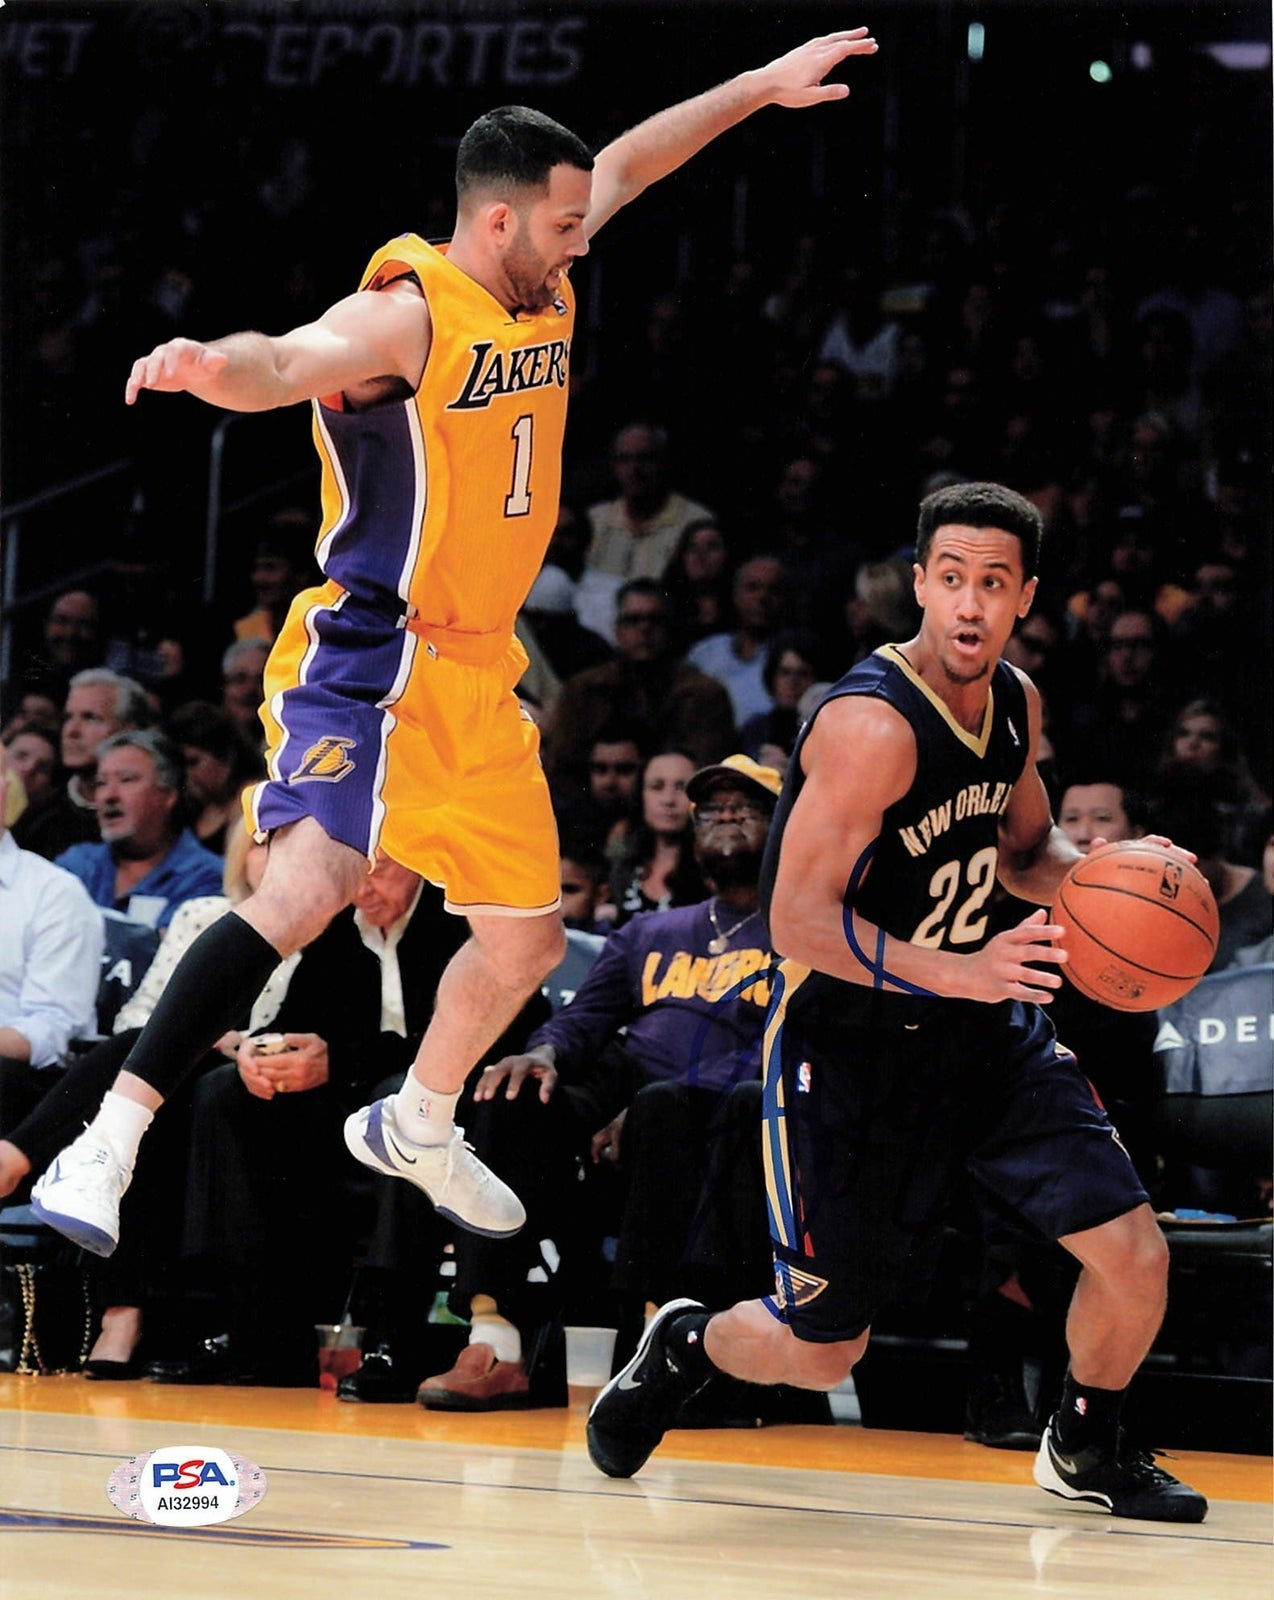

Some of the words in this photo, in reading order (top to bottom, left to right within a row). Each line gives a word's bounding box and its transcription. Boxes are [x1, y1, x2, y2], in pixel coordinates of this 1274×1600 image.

[503, 413, 534, 518] 1
[898, 799, 952, 858] NEW
[910, 846, 998, 950] 22
